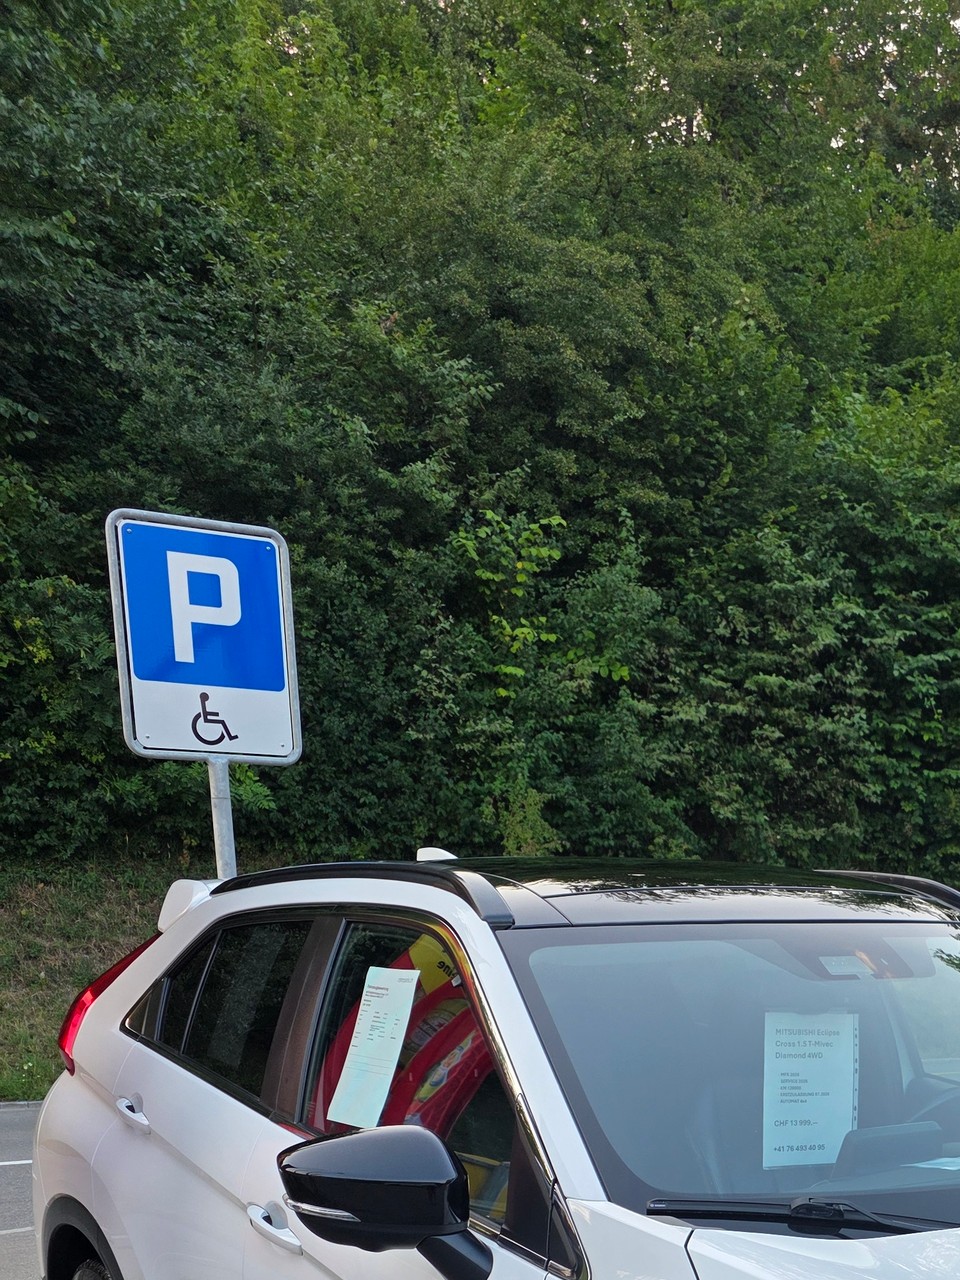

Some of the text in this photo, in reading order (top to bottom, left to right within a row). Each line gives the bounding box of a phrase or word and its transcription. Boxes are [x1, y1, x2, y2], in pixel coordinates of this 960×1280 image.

[166, 550, 242, 664] P
[775, 1028, 840, 1038] MITSUBISHI Eclipse
[775, 1040, 834, 1048] Cross 1.5 T-Mivec
[774, 1119, 789, 1127] CHF
[773, 1145, 785, 1153] +41
[795, 1144, 808, 1152] 493
